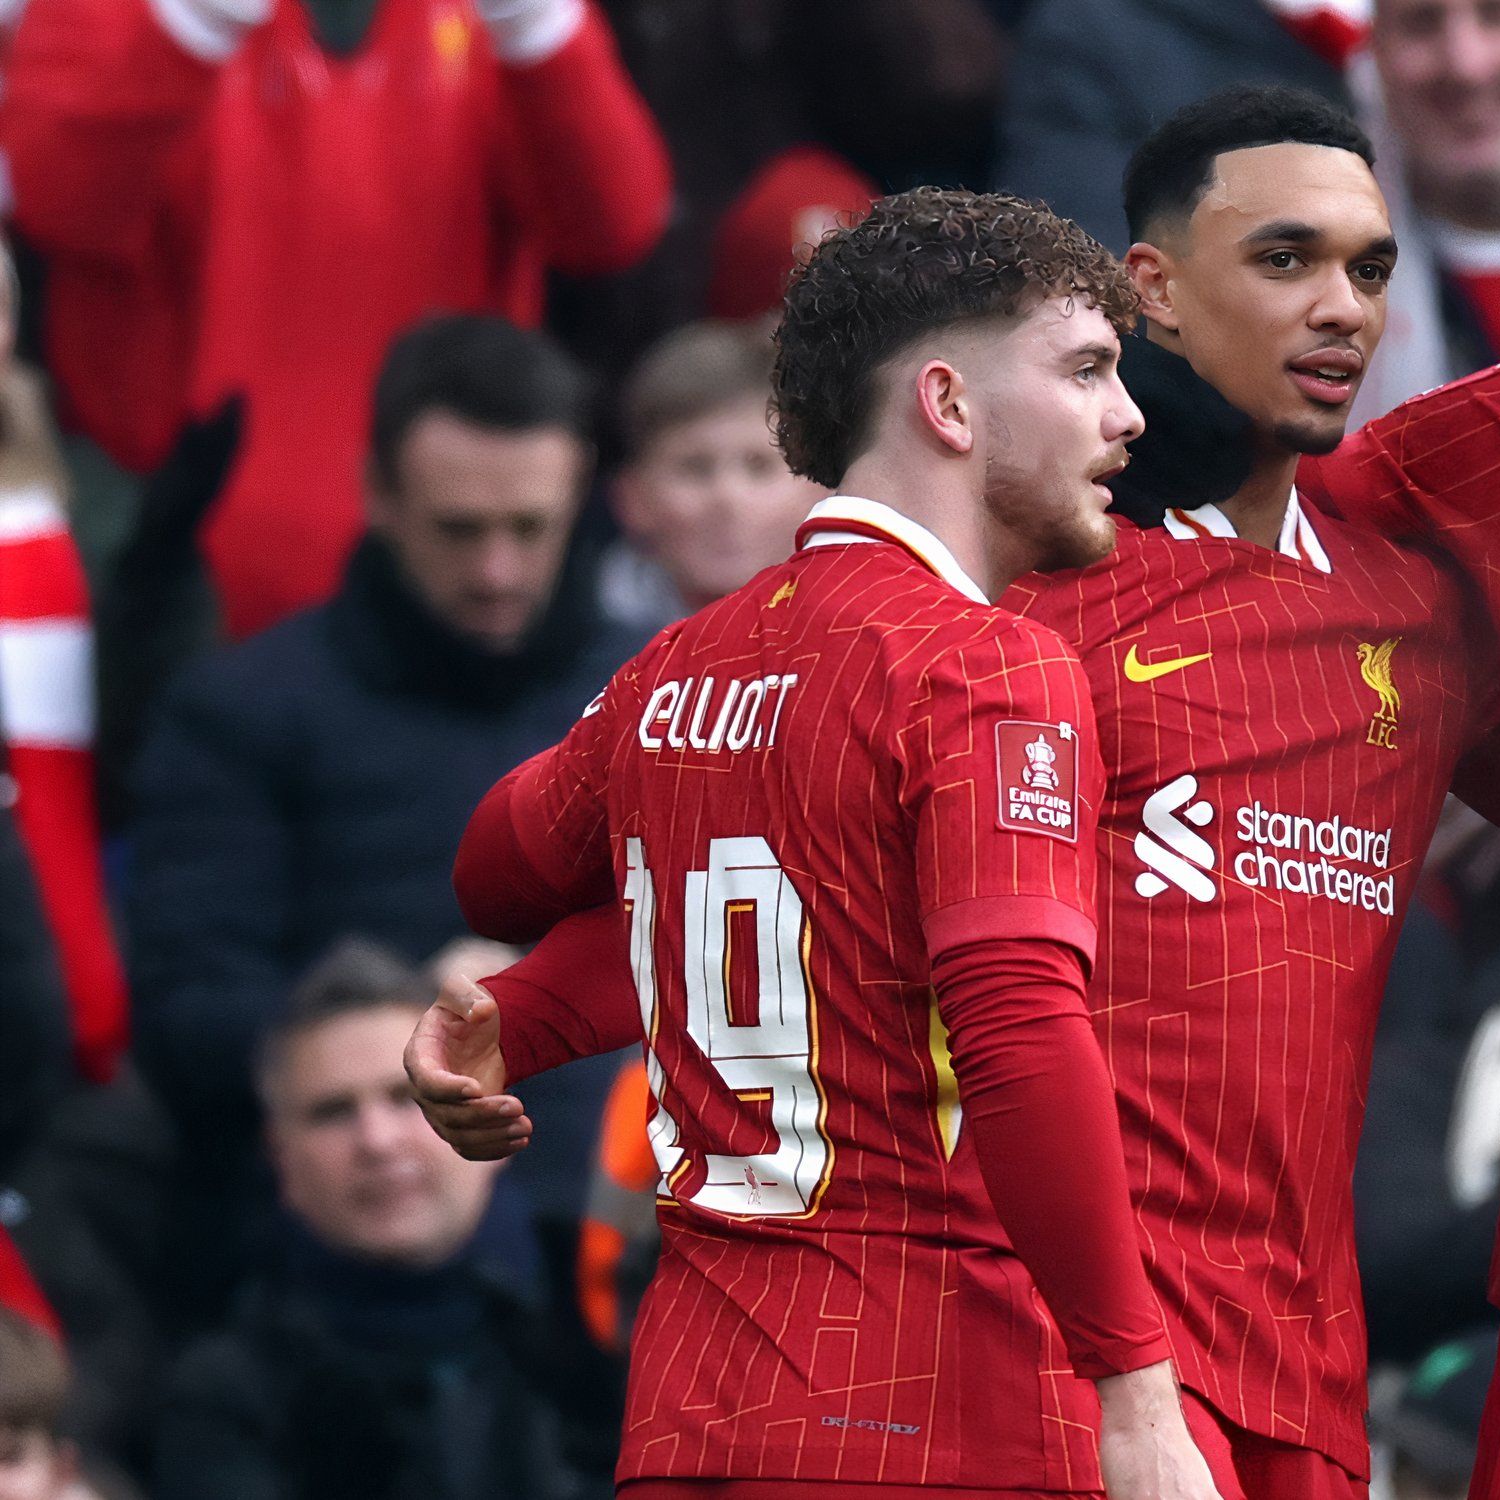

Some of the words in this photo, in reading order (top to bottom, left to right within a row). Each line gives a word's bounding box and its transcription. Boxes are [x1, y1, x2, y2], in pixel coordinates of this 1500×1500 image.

[1009, 802, 1035, 821] FA
[1036, 806, 1072, 829] CUP
[1236, 800, 1392, 870] standard
[1234, 845, 1395, 917] chartered
[623, 836, 833, 1220] 19
